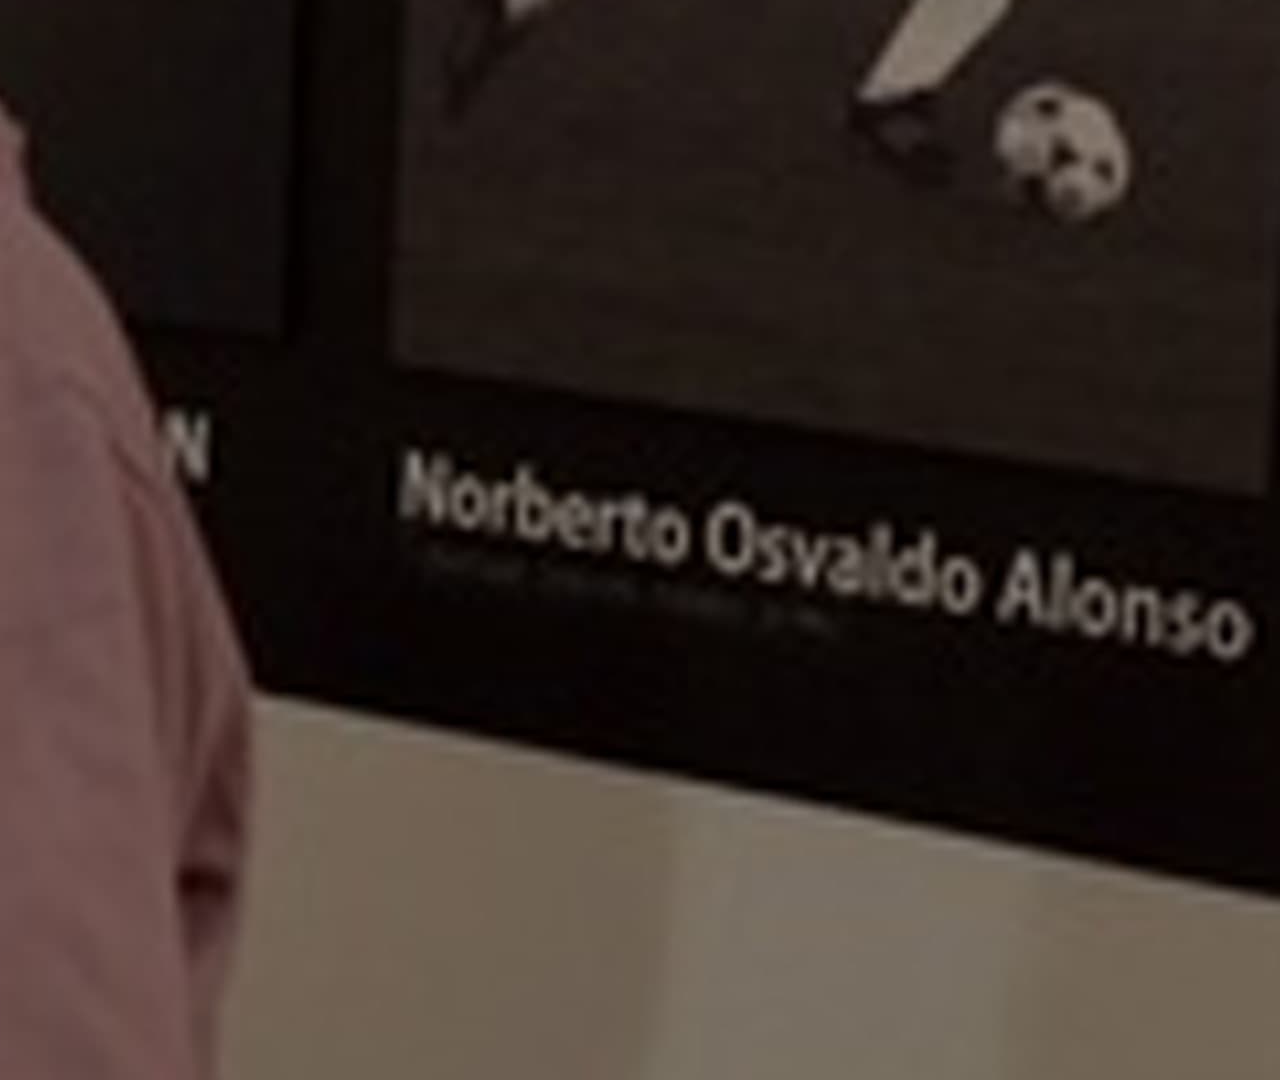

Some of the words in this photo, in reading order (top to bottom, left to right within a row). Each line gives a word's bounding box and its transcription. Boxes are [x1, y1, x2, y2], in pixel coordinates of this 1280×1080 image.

[400, 450, 690, 565] Norberto
[705, 501, 982, 615] Osvaldo
[996, 549, 1254, 660] Alonso
